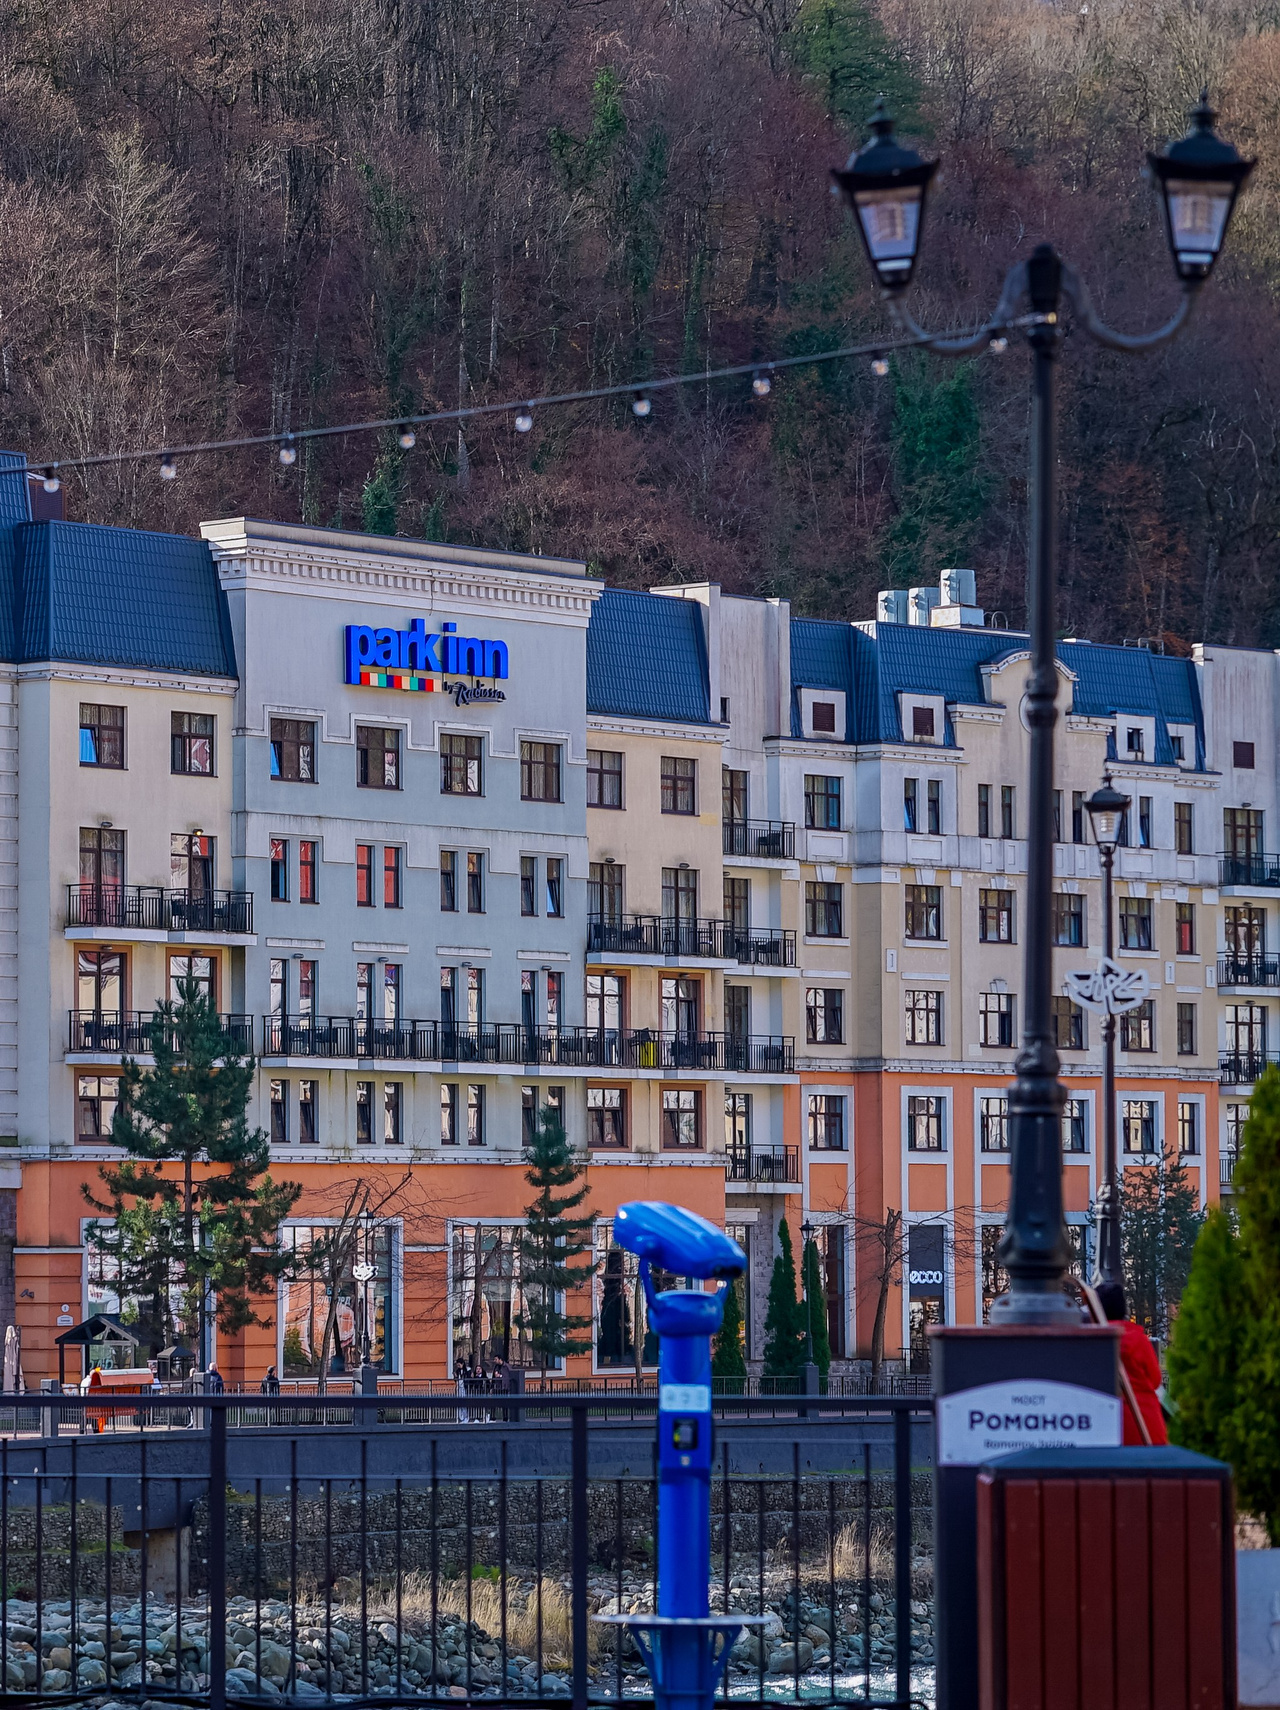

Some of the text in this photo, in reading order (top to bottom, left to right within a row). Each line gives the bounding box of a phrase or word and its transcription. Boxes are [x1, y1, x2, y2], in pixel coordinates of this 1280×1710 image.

[344, 618, 509, 685] park inn
[454, 679, 507, 707] Radisson
[969, 1410, 1092, 1431] Романов
